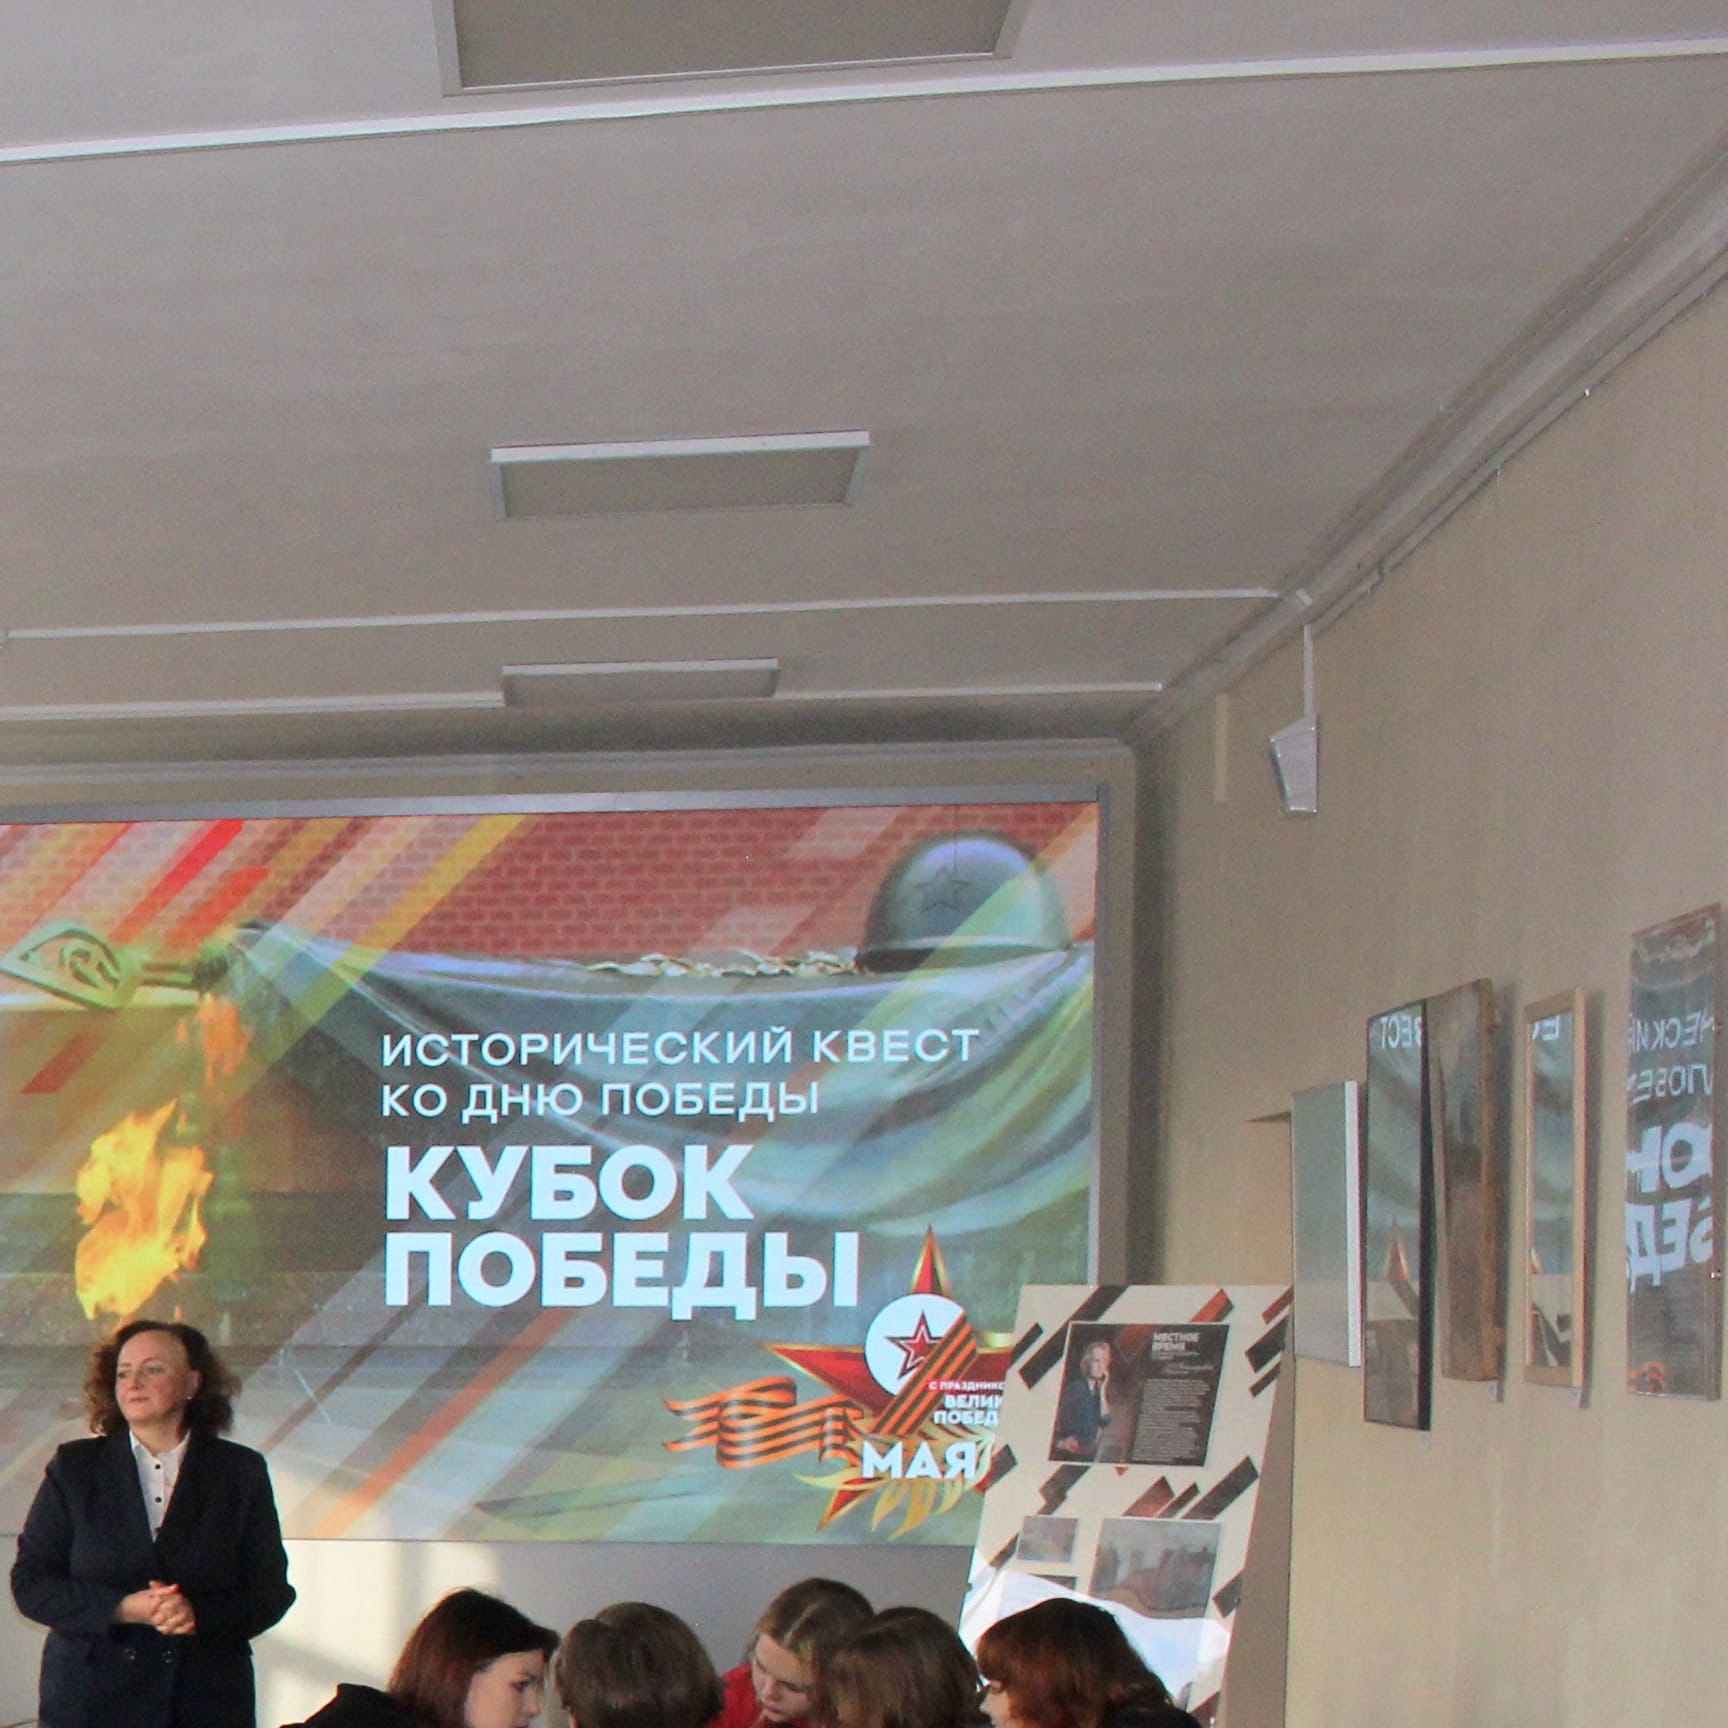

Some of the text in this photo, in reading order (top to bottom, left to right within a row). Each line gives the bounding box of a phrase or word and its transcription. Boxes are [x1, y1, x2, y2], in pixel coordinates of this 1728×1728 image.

[382, 1026, 980, 1067] ИСТОРИЧЕСКИЙ КВЕСТ
[382, 1081, 819, 1125] КО ДНЮ ПОБЕДЫ
[384, 1143, 755, 1220] КУБОК
[384, 1231, 859, 1321] ПОБЕДЫ
[928, 1381, 938, 1390] С
[862, 1440, 977, 1480] МАЯ
